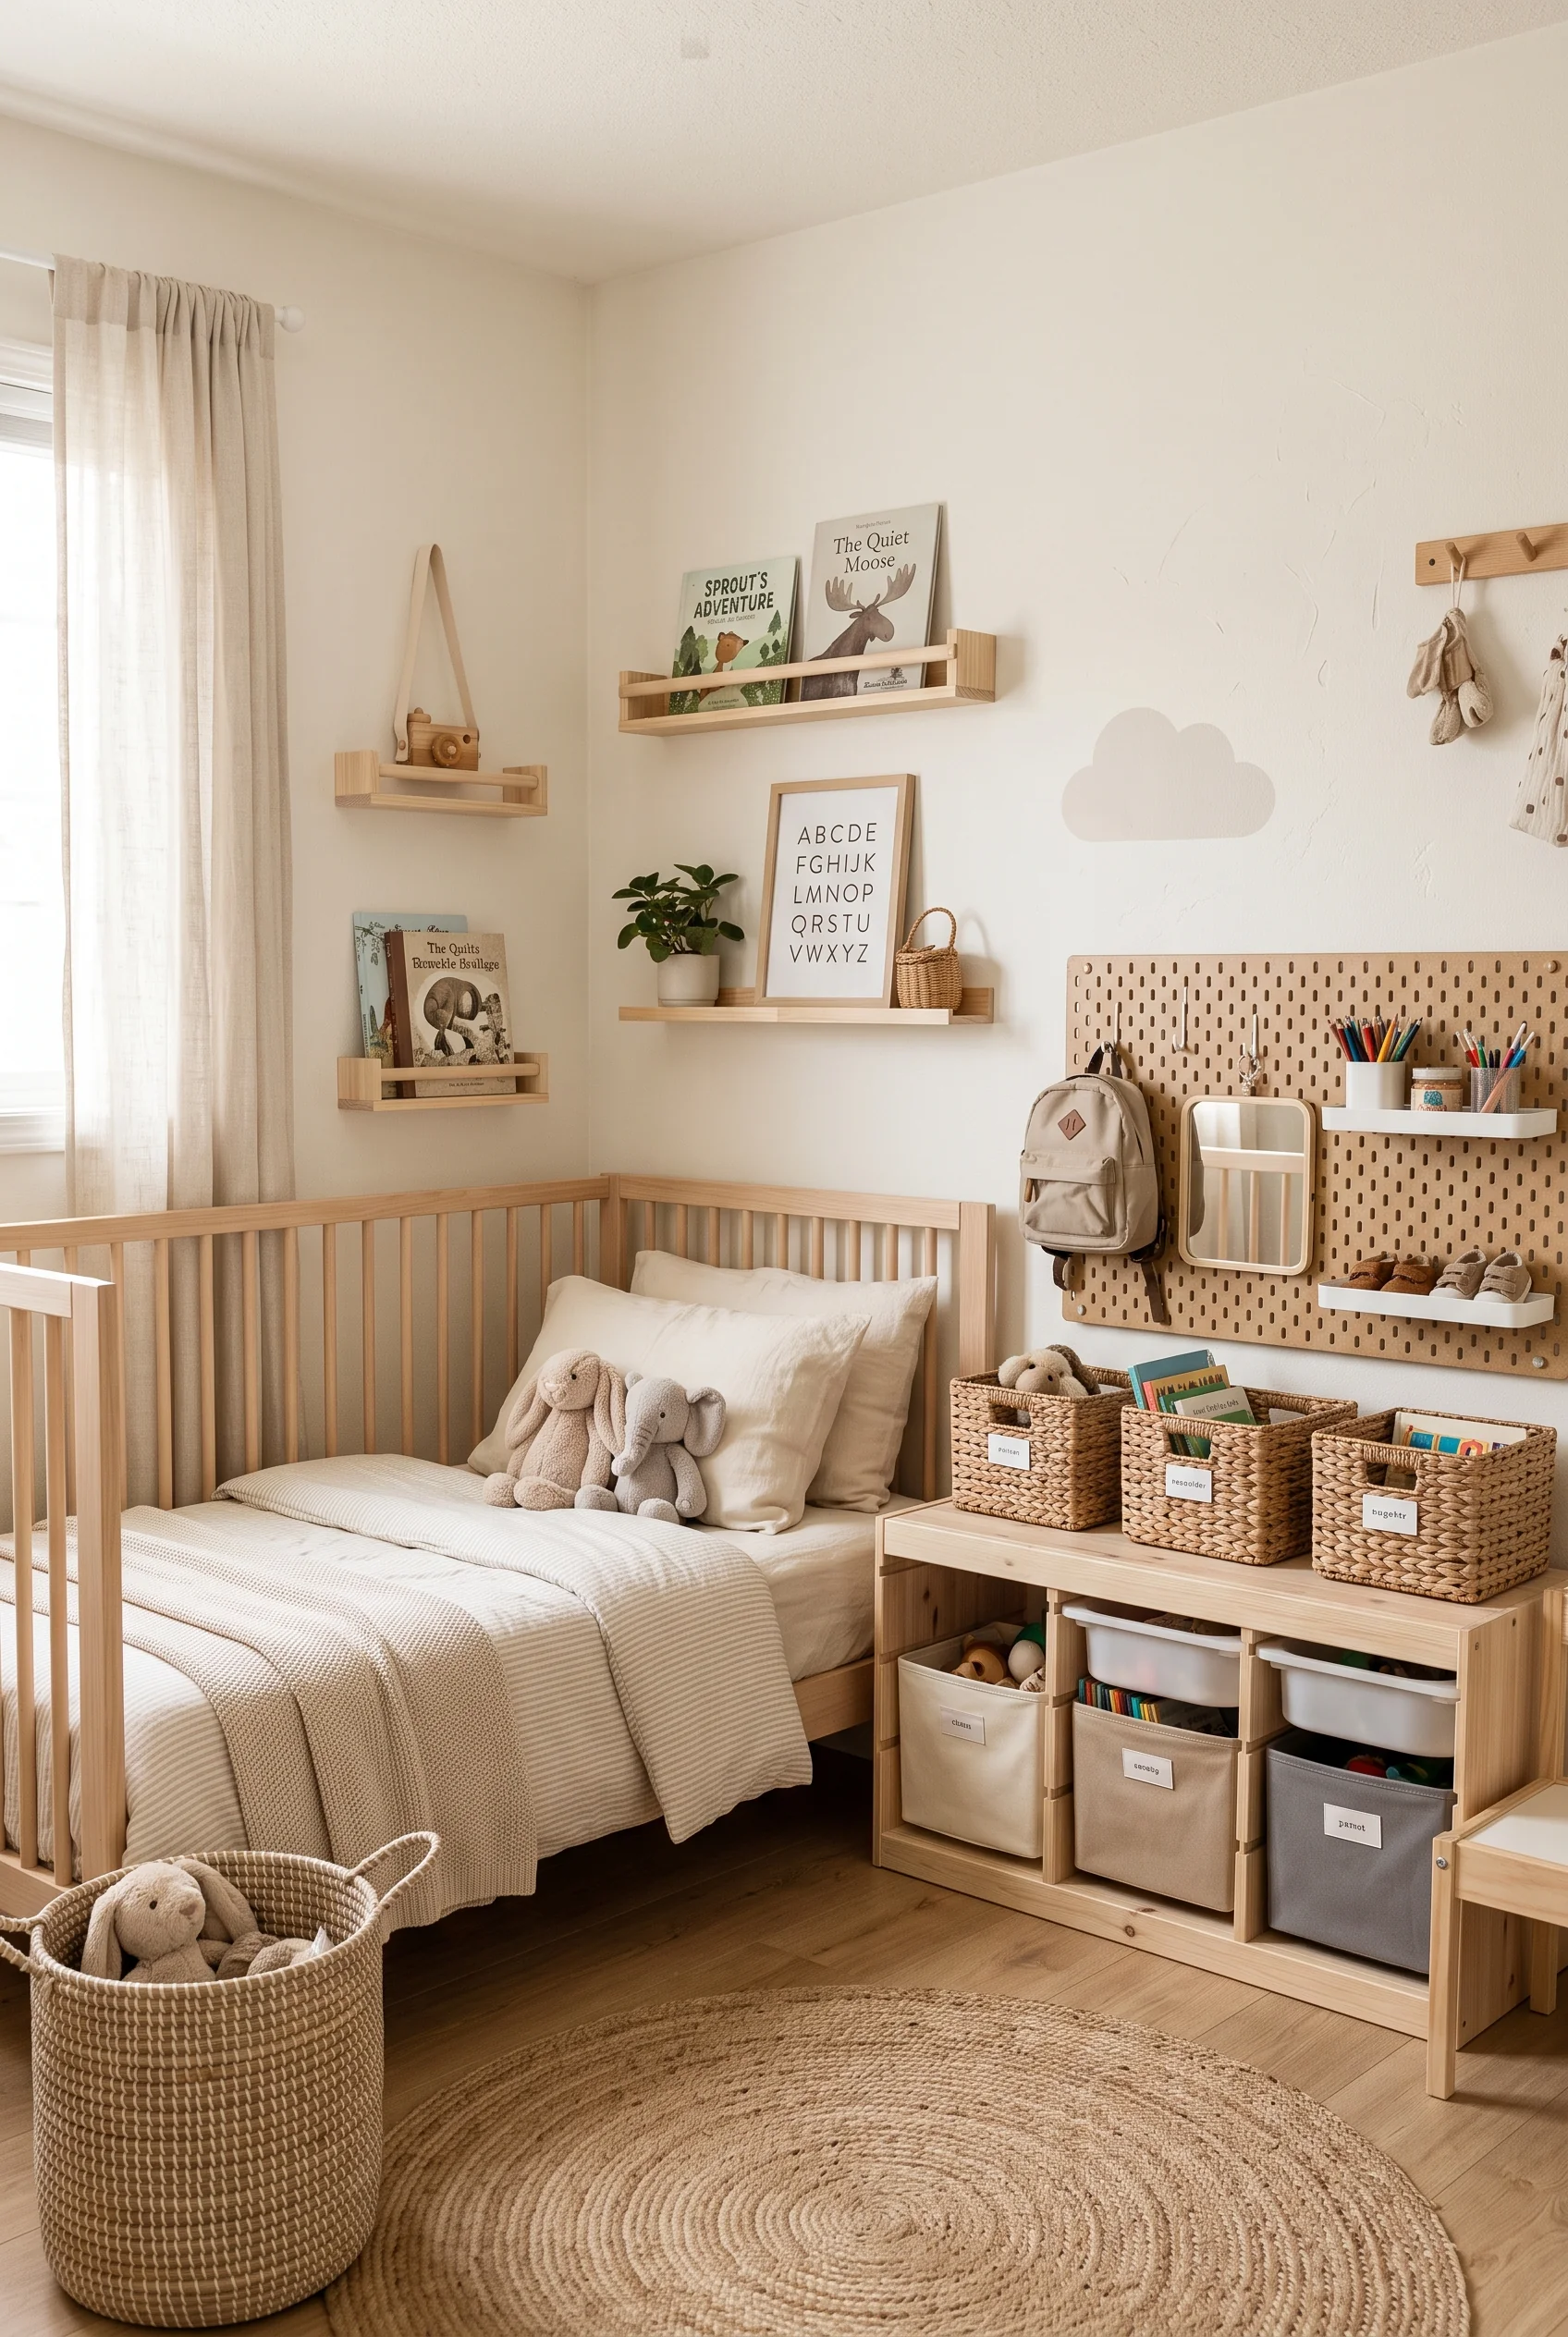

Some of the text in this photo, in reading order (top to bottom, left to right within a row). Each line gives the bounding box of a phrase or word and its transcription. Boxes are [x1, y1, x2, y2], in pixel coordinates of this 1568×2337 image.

[834, 530, 910, 555] The Quiet
[844, 556, 896, 574] Moose
[704, 571, 768, 597] SPROUT'S
[693, 592, 774, 618] ADVENTURE
[797, 822, 877, 845] ABCDE
[796, 852, 876, 875] FGHIJK
[793, 884, 874, 904] LMNOP
[791, 913, 870, 938] QRSTU
[427, 941, 480, 956] The Quilts
[790, 944, 869, 963] VWXYZ
